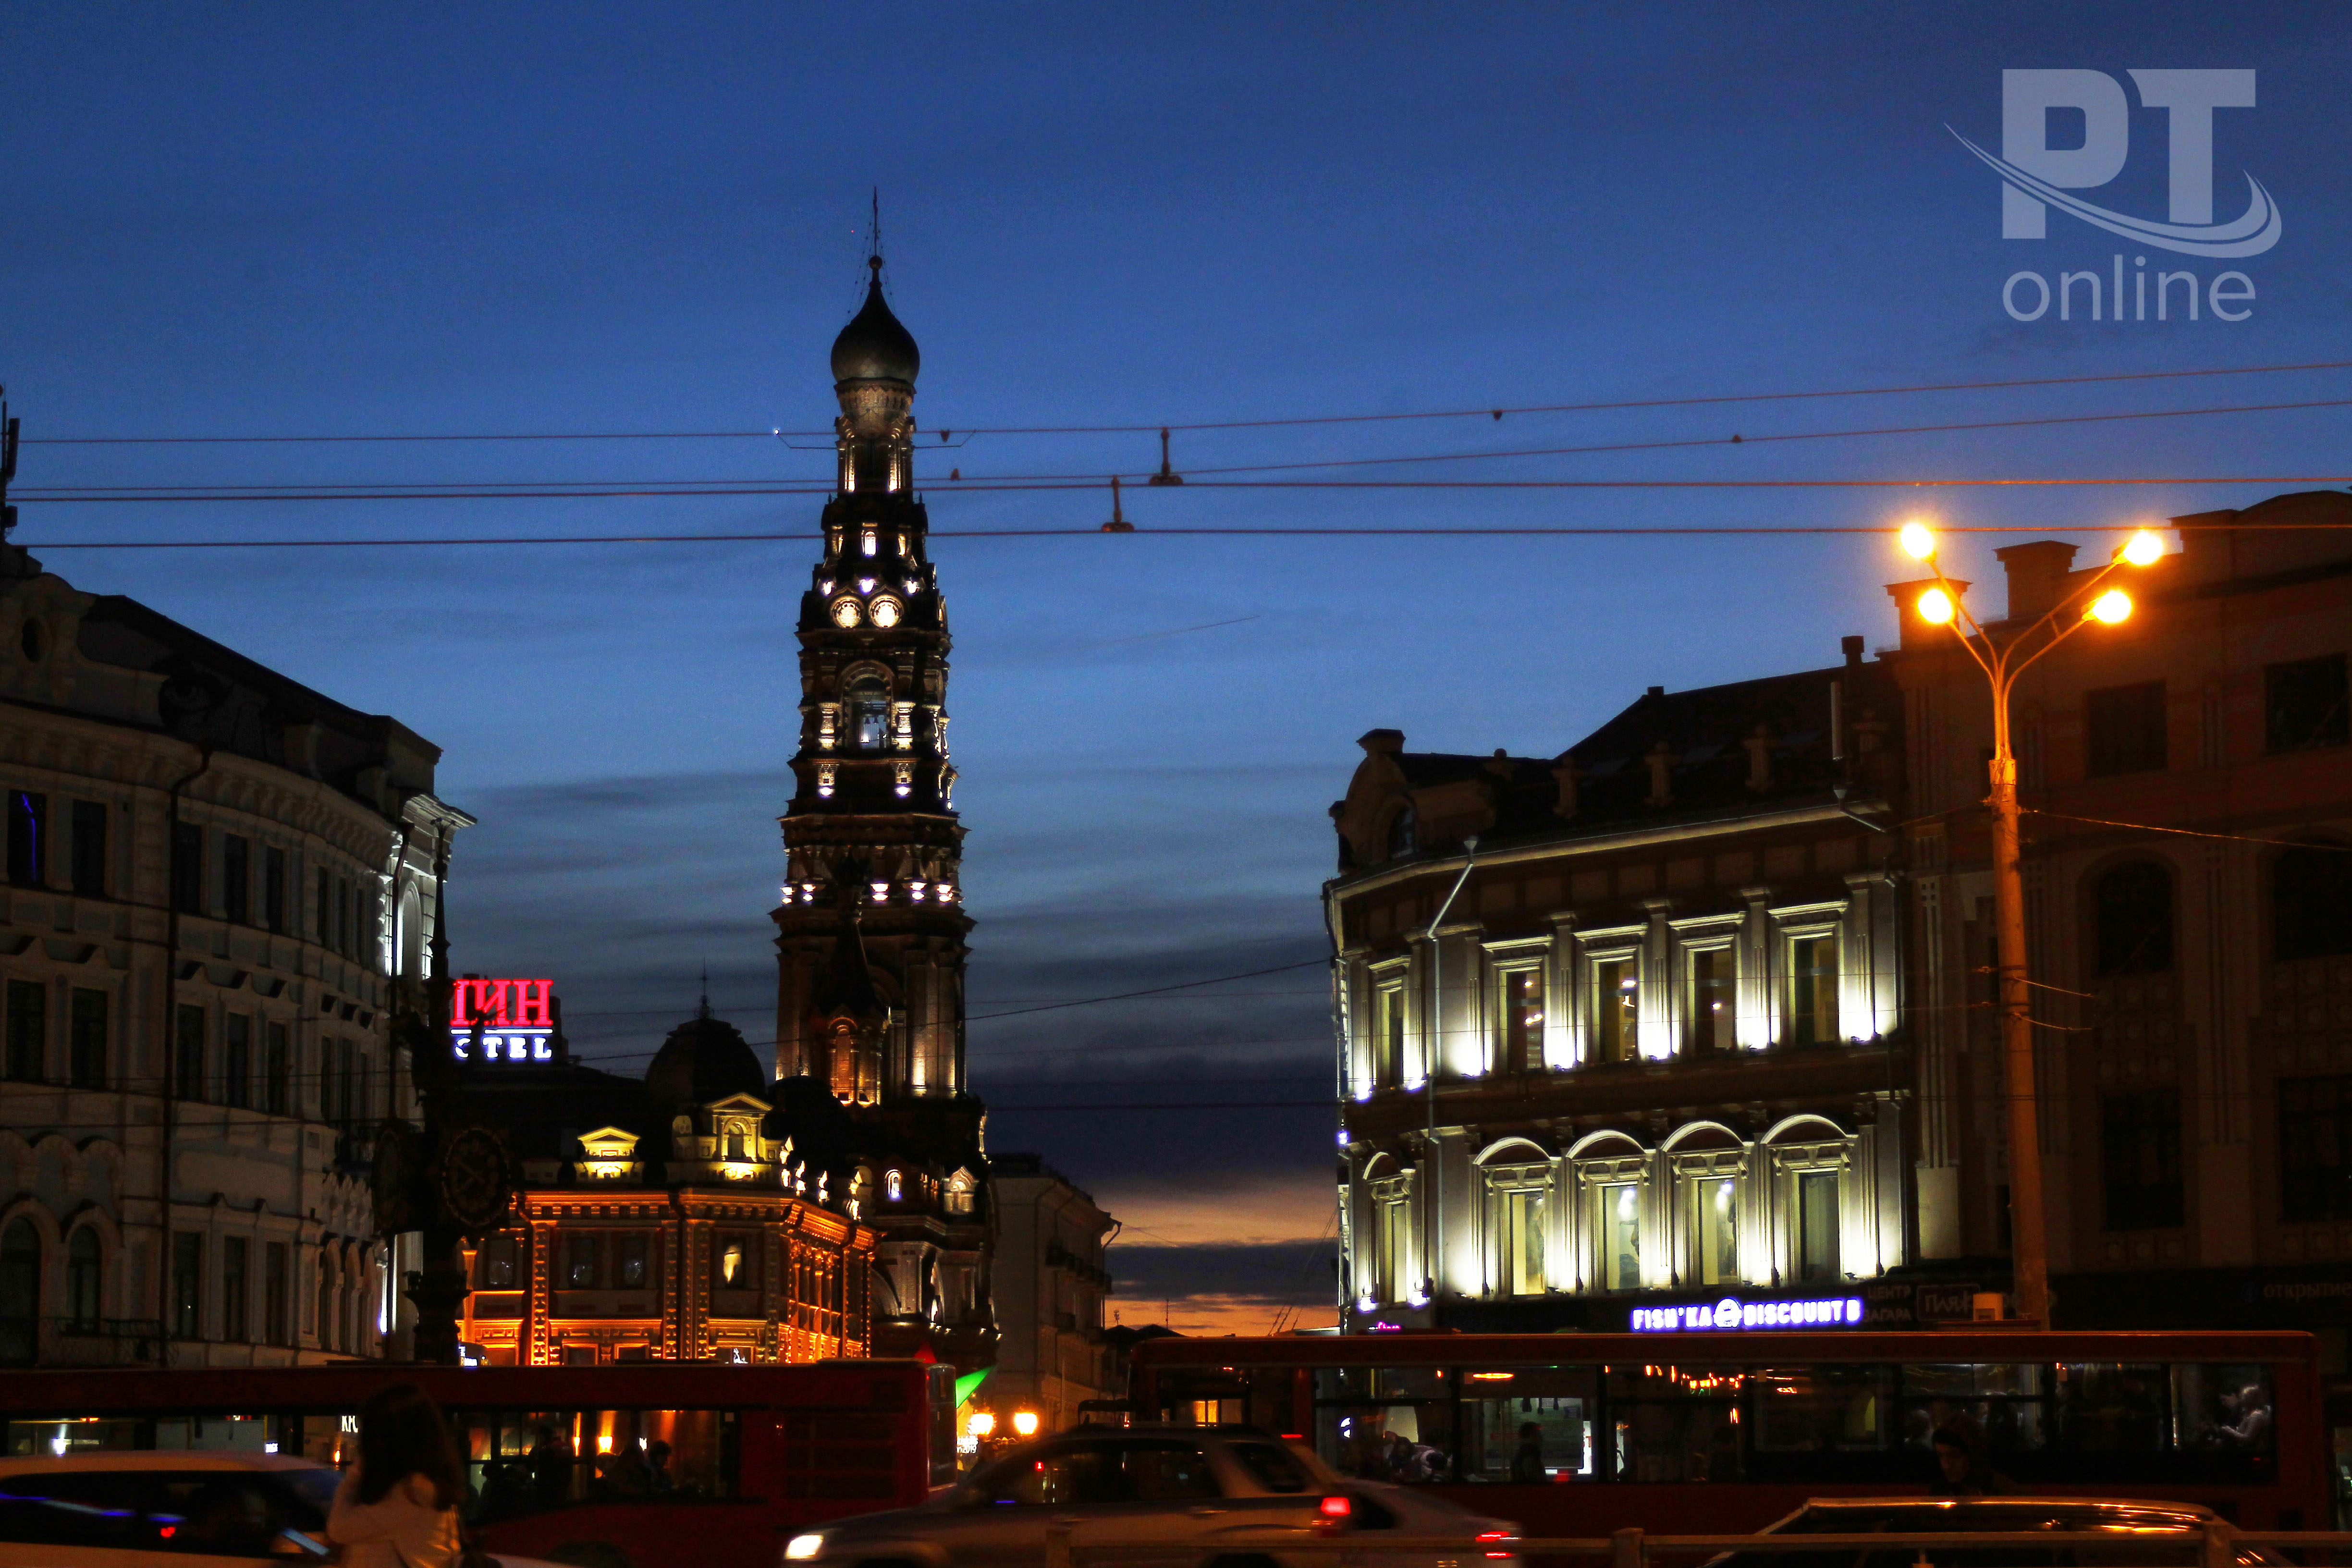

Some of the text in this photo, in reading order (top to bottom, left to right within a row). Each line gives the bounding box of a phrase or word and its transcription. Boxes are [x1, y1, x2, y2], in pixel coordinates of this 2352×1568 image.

[1867, 1285, 1911, 1301] ЦЕНТР
[1744, 1300, 1842, 1326] DISCOUNT
[1863, 1308, 1911, 1323] ЗАГАРА
